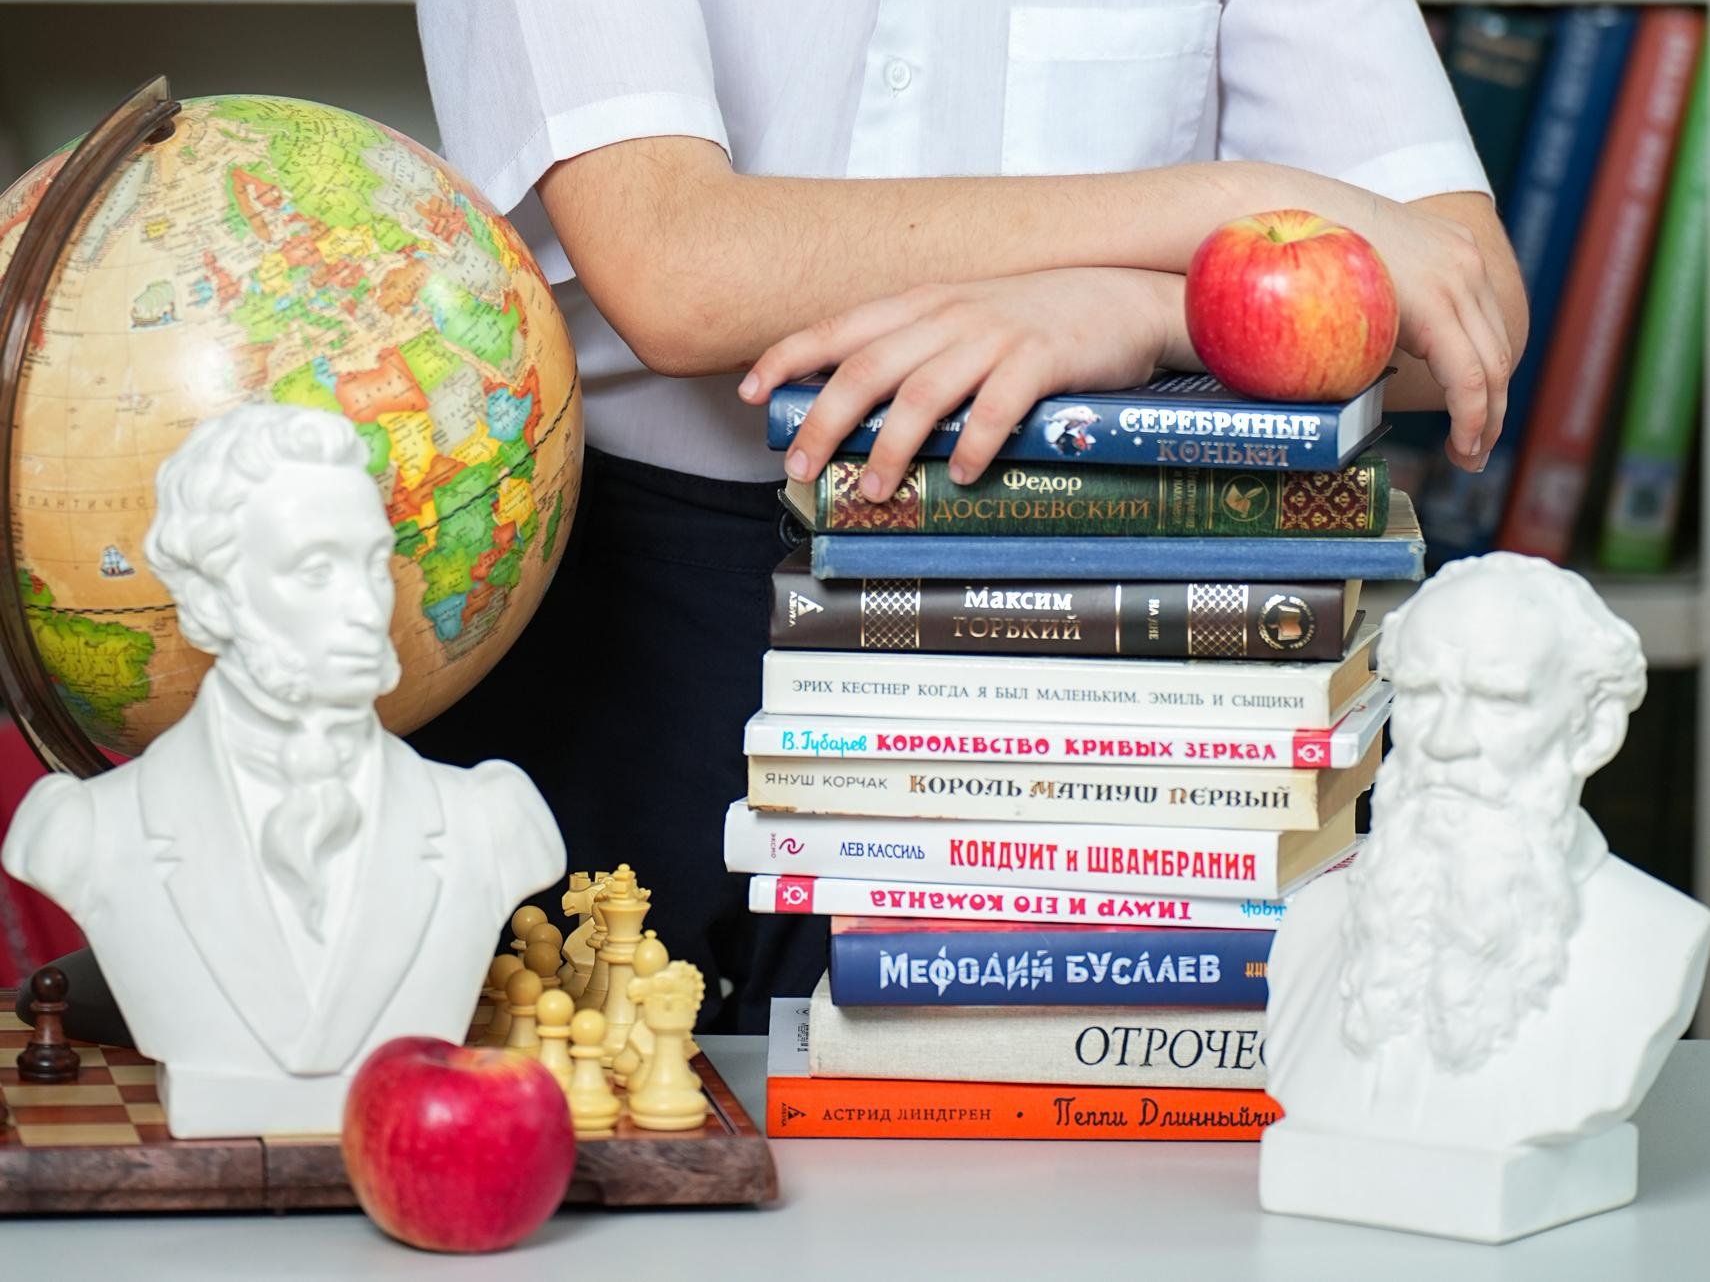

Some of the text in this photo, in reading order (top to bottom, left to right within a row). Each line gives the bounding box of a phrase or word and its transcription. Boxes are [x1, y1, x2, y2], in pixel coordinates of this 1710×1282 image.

[1118, 407, 1321, 441] СЕРЕБРЯНЫЕ
[1156, 438, 1289, 467] КОНЬКИ
[1003, 469, 1082, 496] Федор
[933, 498, 1150, 522] ДОСТОЕВСКИЙ
[788, 591, 798, 627] АЗБУКА
[964, 586, 1073, 611] Максим
[1148, 598, 1160, 616] НА
[952, 615, 1082, 640] ГОРЬКИЙ
[792, 679, 1304, 710] ЭРИХ КЕСТНЕР КОГДА Я БЫЛ МАЛЕНЬКИМ. ЭМИЛЬ И СЫЩИКИ
[877, 733, 1050, 755] КОРОЛЕВСТВО
[1065, 738, 1173, 757] КРИВЫХ
[764, 772, 1291, 809] ЯНУШ КОРЧАК КОРОЛЬ МАТИУШ ПЕРВЫЙ
[840, 840, 864, 857] ЛЕВ
[867, 842, 925, 860] КАССИЛЬ
[950, 839, 1058, 871] КОНДУИТ
[1087, 845, 1256, 881] ШВАМБРАНИЯ
[1014, 894, 1059, 914] ЕГО
[1069, 897, 1087, 915] И
[1097, 899, 1192, 920] ТИМУР
[1065, 950, 1221, 985] БУСЛАЕВ
[823, 1108, 892, 1123] АСТРИД
[897, 1108, 992, 1123] ЛИНДГРЕН
[1054, 1096, 1128, 1127] Пеппи
